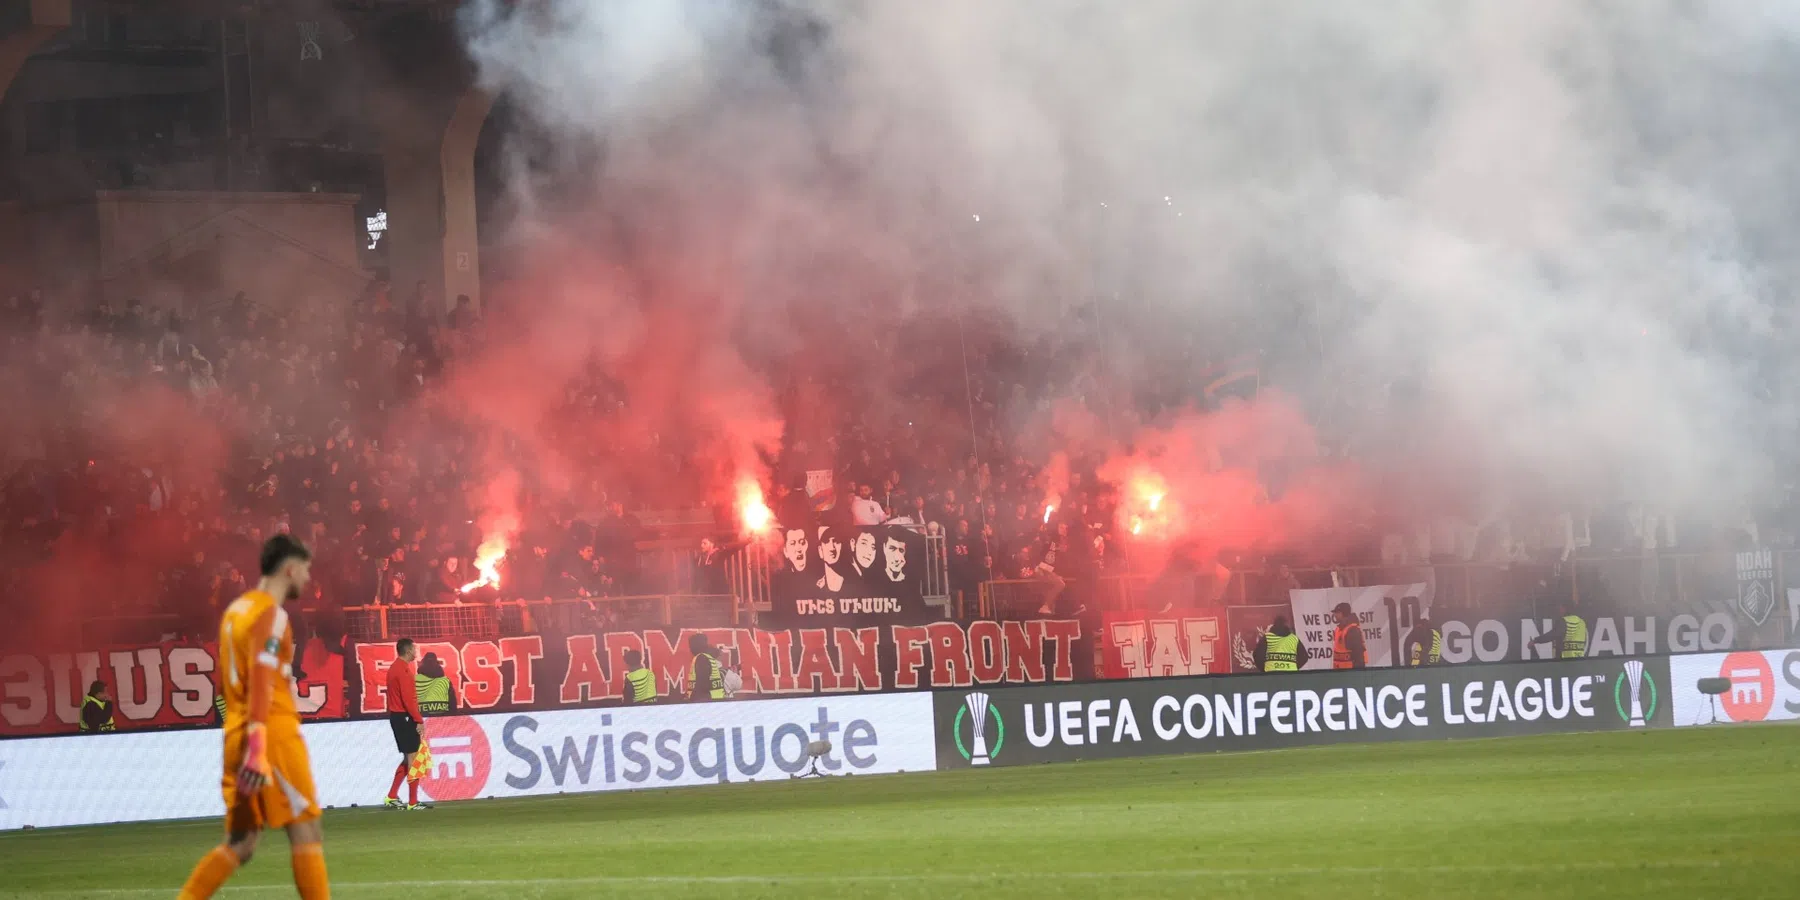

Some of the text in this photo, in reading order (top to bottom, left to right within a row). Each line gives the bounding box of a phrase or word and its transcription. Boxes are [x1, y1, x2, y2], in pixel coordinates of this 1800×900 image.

[1736, 551, 1772, 570] NOAH
[1303, 611, 1374, 626] WE DO SIT
[1305, 630, 1323, 642] WE
[1363, 628, 1382, 640] THE
[1441, 612, 1736, 663] GO NAH GO
[1307, 647, 1333, 659] STAD
[355, 636, 544, 713] FRST
[892, 619, 1081, 688] FRONT
[418, 702, 449, 712] TEWAR
[1024, 699, 1141, 747] UEFA
[1153, 683, 1428, 741] CONFERENCE
[504, 706, 877, 787] Swissquote
